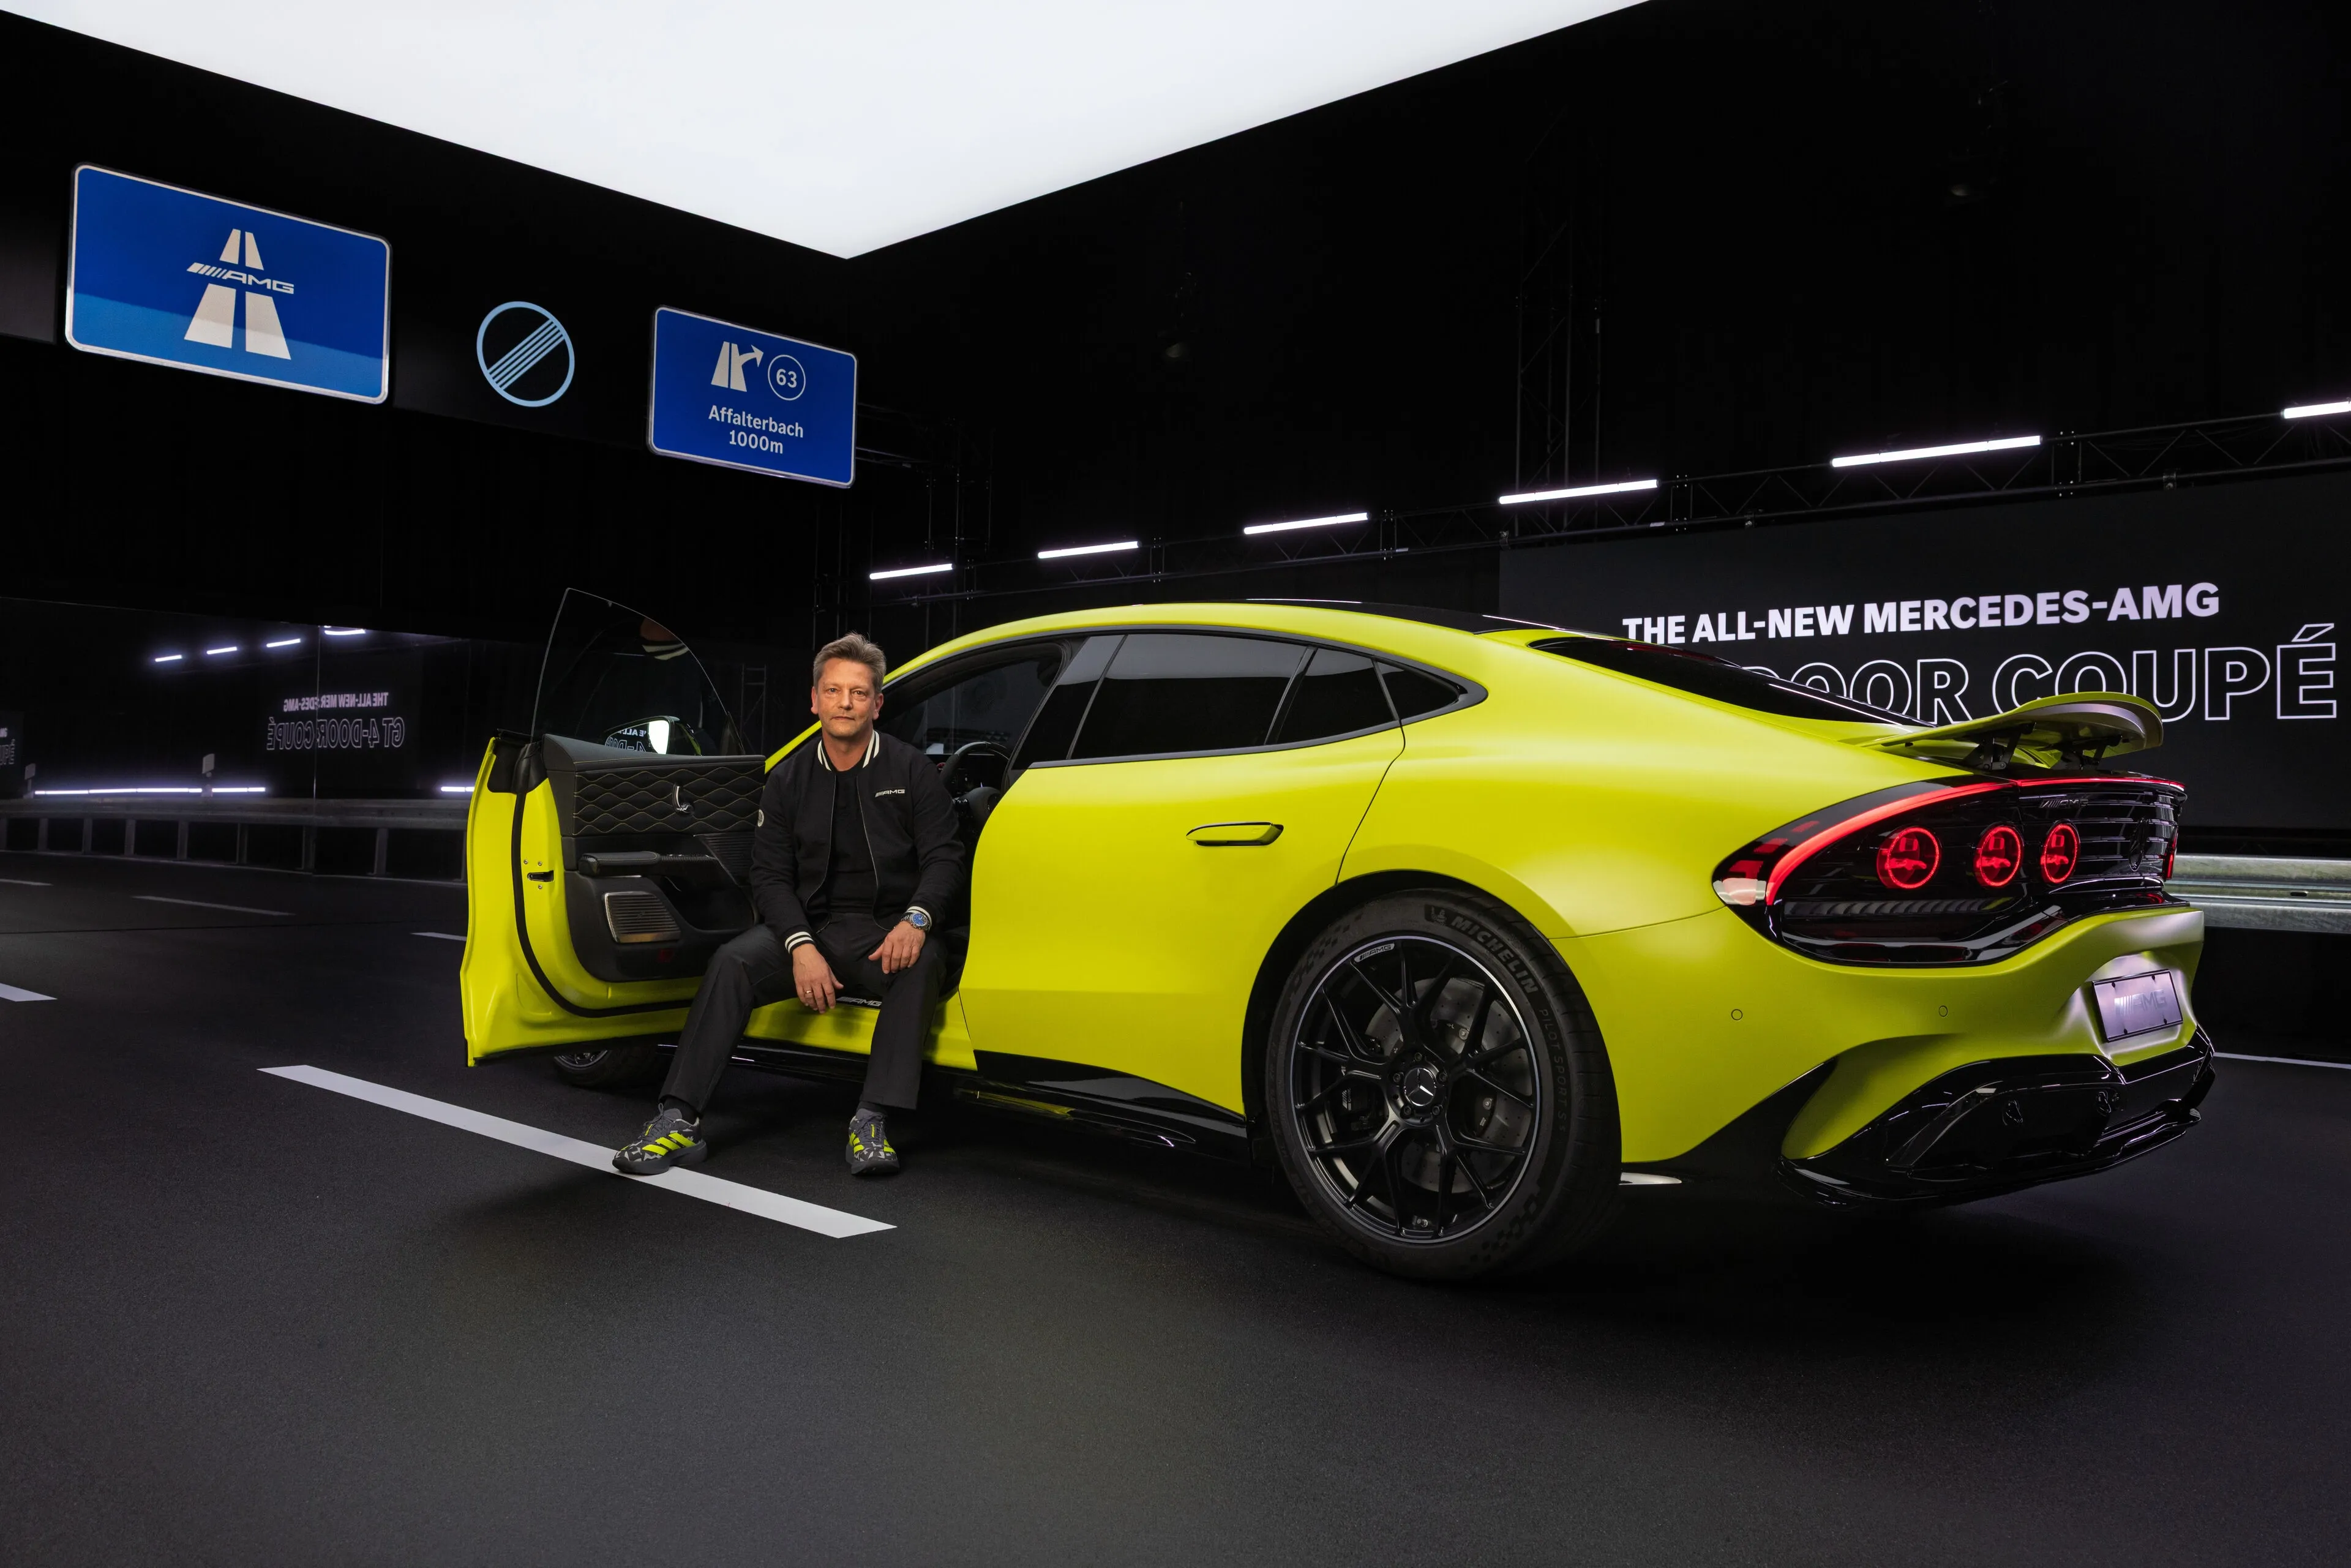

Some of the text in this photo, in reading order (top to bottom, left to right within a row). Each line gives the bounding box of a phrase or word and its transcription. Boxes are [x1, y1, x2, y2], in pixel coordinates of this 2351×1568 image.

[222, 269, 294, 294] AMG
[776, 369, 797, 388] 63
[708, 405, 803, 438] Affalterbach
[729, 430, 783, 454] 1000m
[1622, 582, 2219, 645] THE ALL-NEW MERCEDES-AMG
[1992, 623, 2337, 722] COUPÉ
[1451, 915, 1539, 994] MICHELIN
[1539, 1008, 1561, 1051] PILOT
[1553, 1055, 1568, 1106] SPORT
